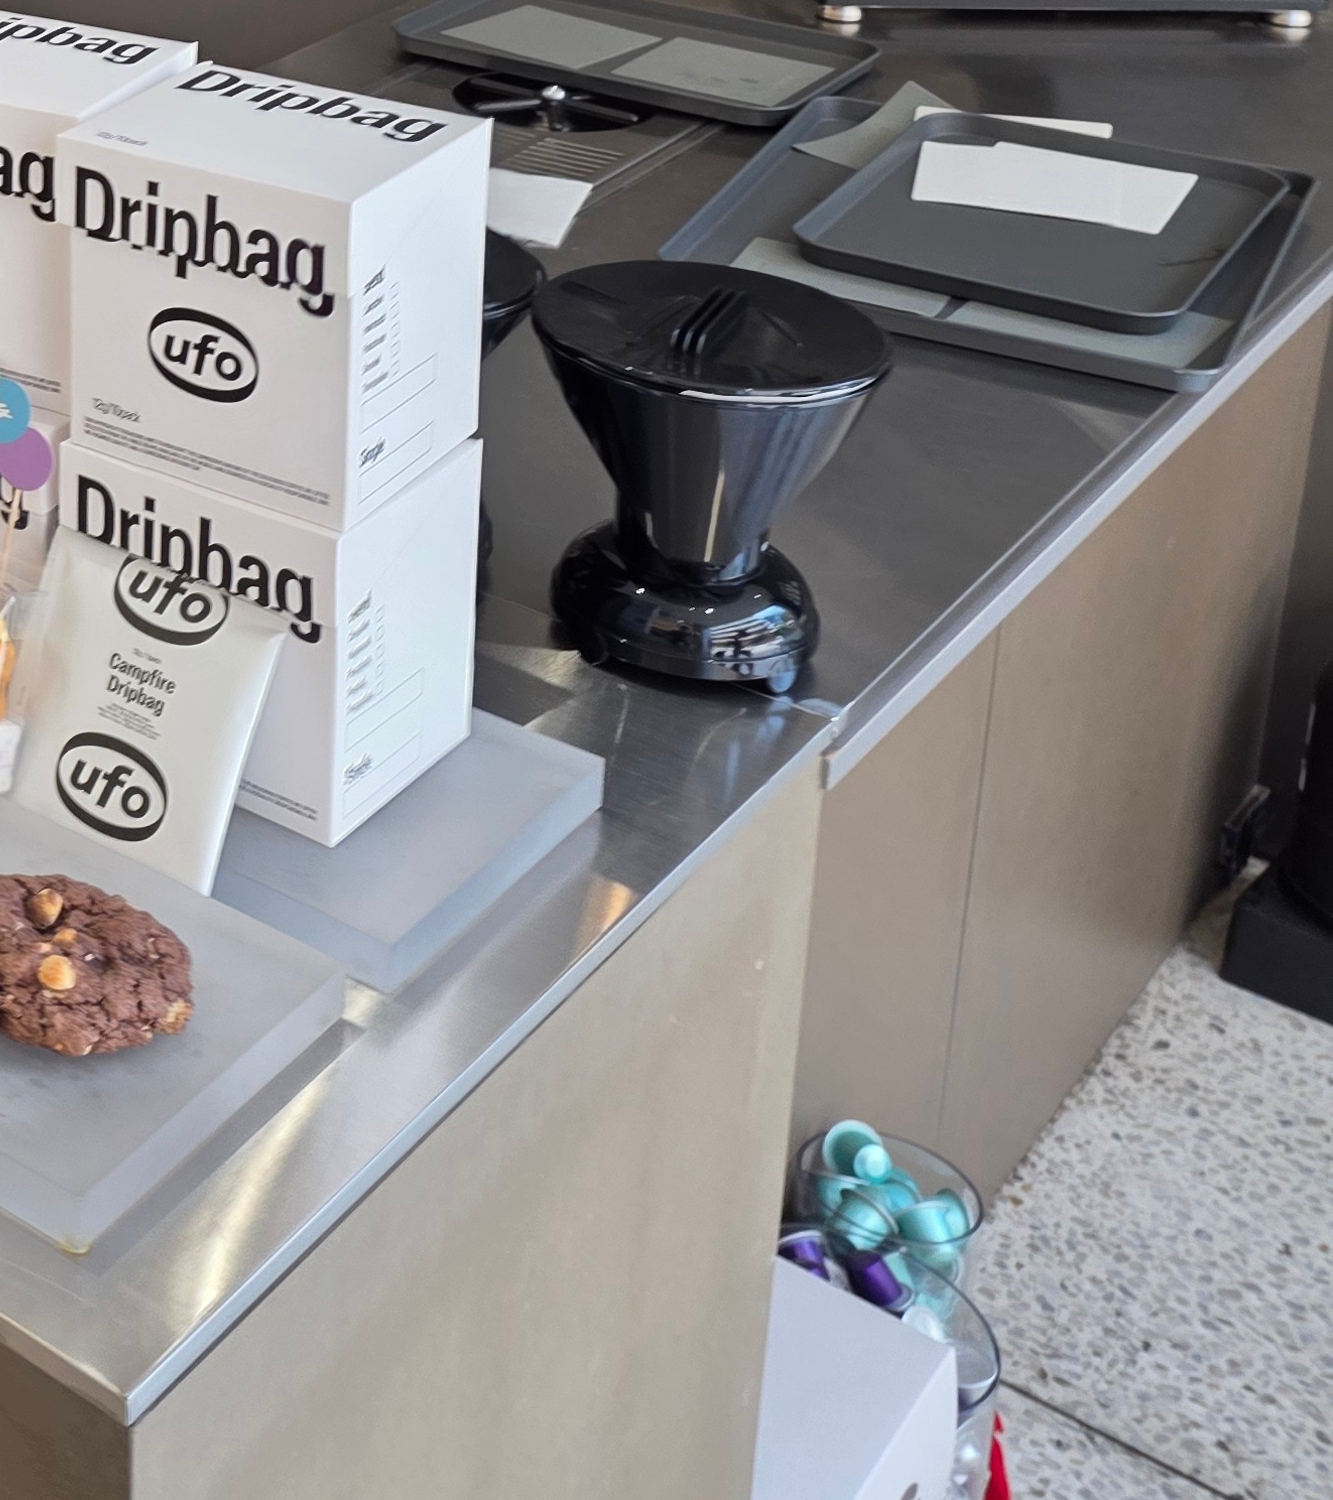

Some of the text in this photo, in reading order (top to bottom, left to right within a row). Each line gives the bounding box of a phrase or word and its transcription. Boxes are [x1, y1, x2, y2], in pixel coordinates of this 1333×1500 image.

[175, 69, 449, 143] Dripbag
[75, 165, 336, 318] Dripbag
[161, 328, 243, 382] ufo
[77, 473, 323, 644] Dripbag
[128, 568, 212, 623] ufo
[106, 673, 166, 717] Dripbag
[109, 652, 177, 694] Campfire
[69, 758, 151, 819] ufo
